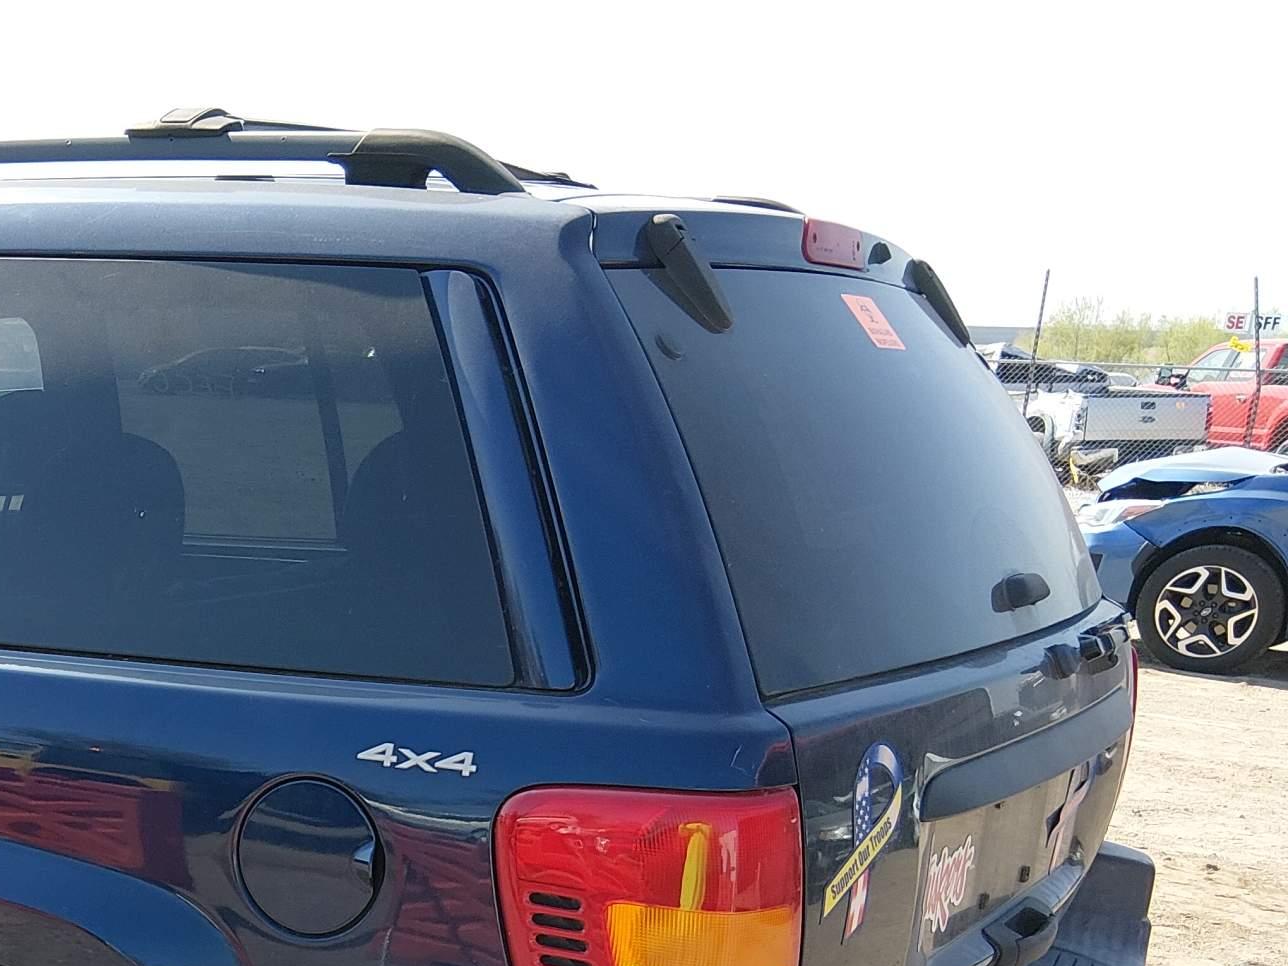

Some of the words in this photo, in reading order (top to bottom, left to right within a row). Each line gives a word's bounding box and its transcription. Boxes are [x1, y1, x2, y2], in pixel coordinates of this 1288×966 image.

[830, 858, 859, 900] Support
[857, 845, 871, 867] Our
[868, 817, 893, 852] Troops
